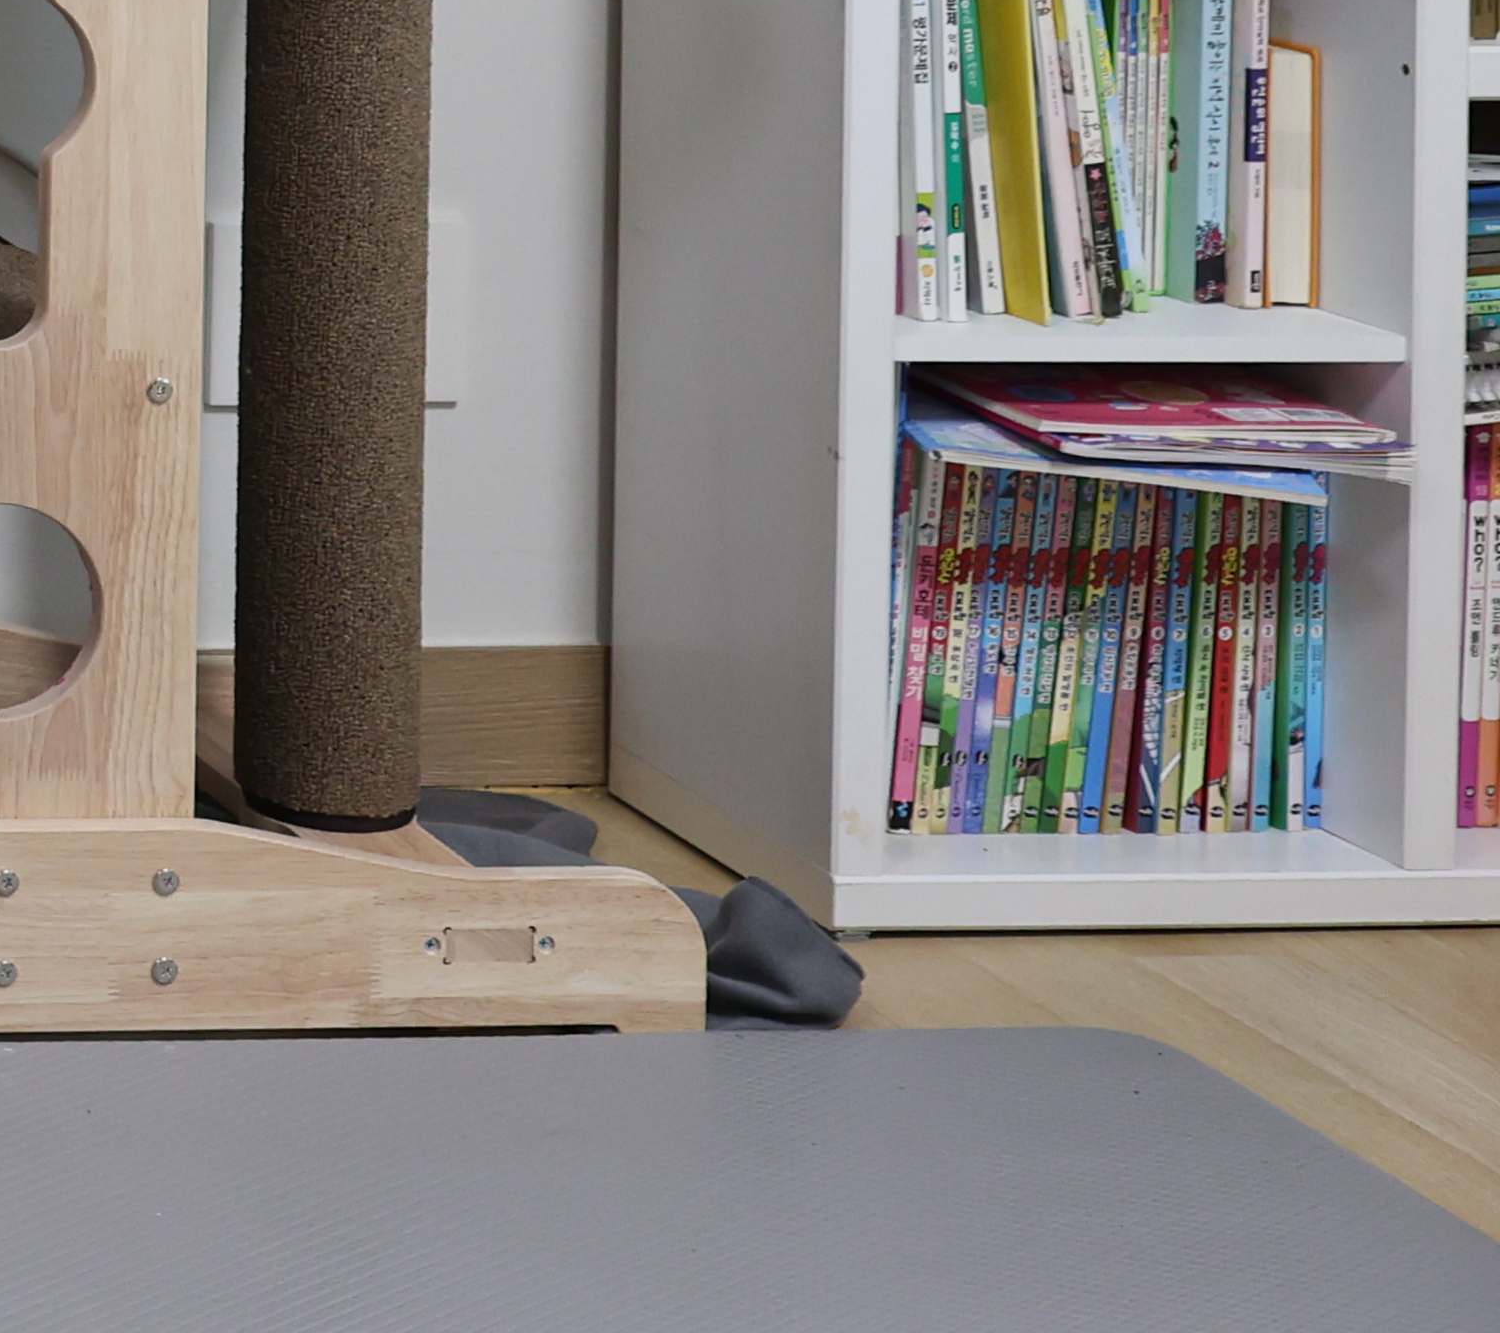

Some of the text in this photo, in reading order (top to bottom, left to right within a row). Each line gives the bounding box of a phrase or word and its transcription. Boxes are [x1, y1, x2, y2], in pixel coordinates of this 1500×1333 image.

[962, 27, 979, 87] master
[910, 626, 928, 662] 비밀
[904, 665, 924, 700] 찾기
